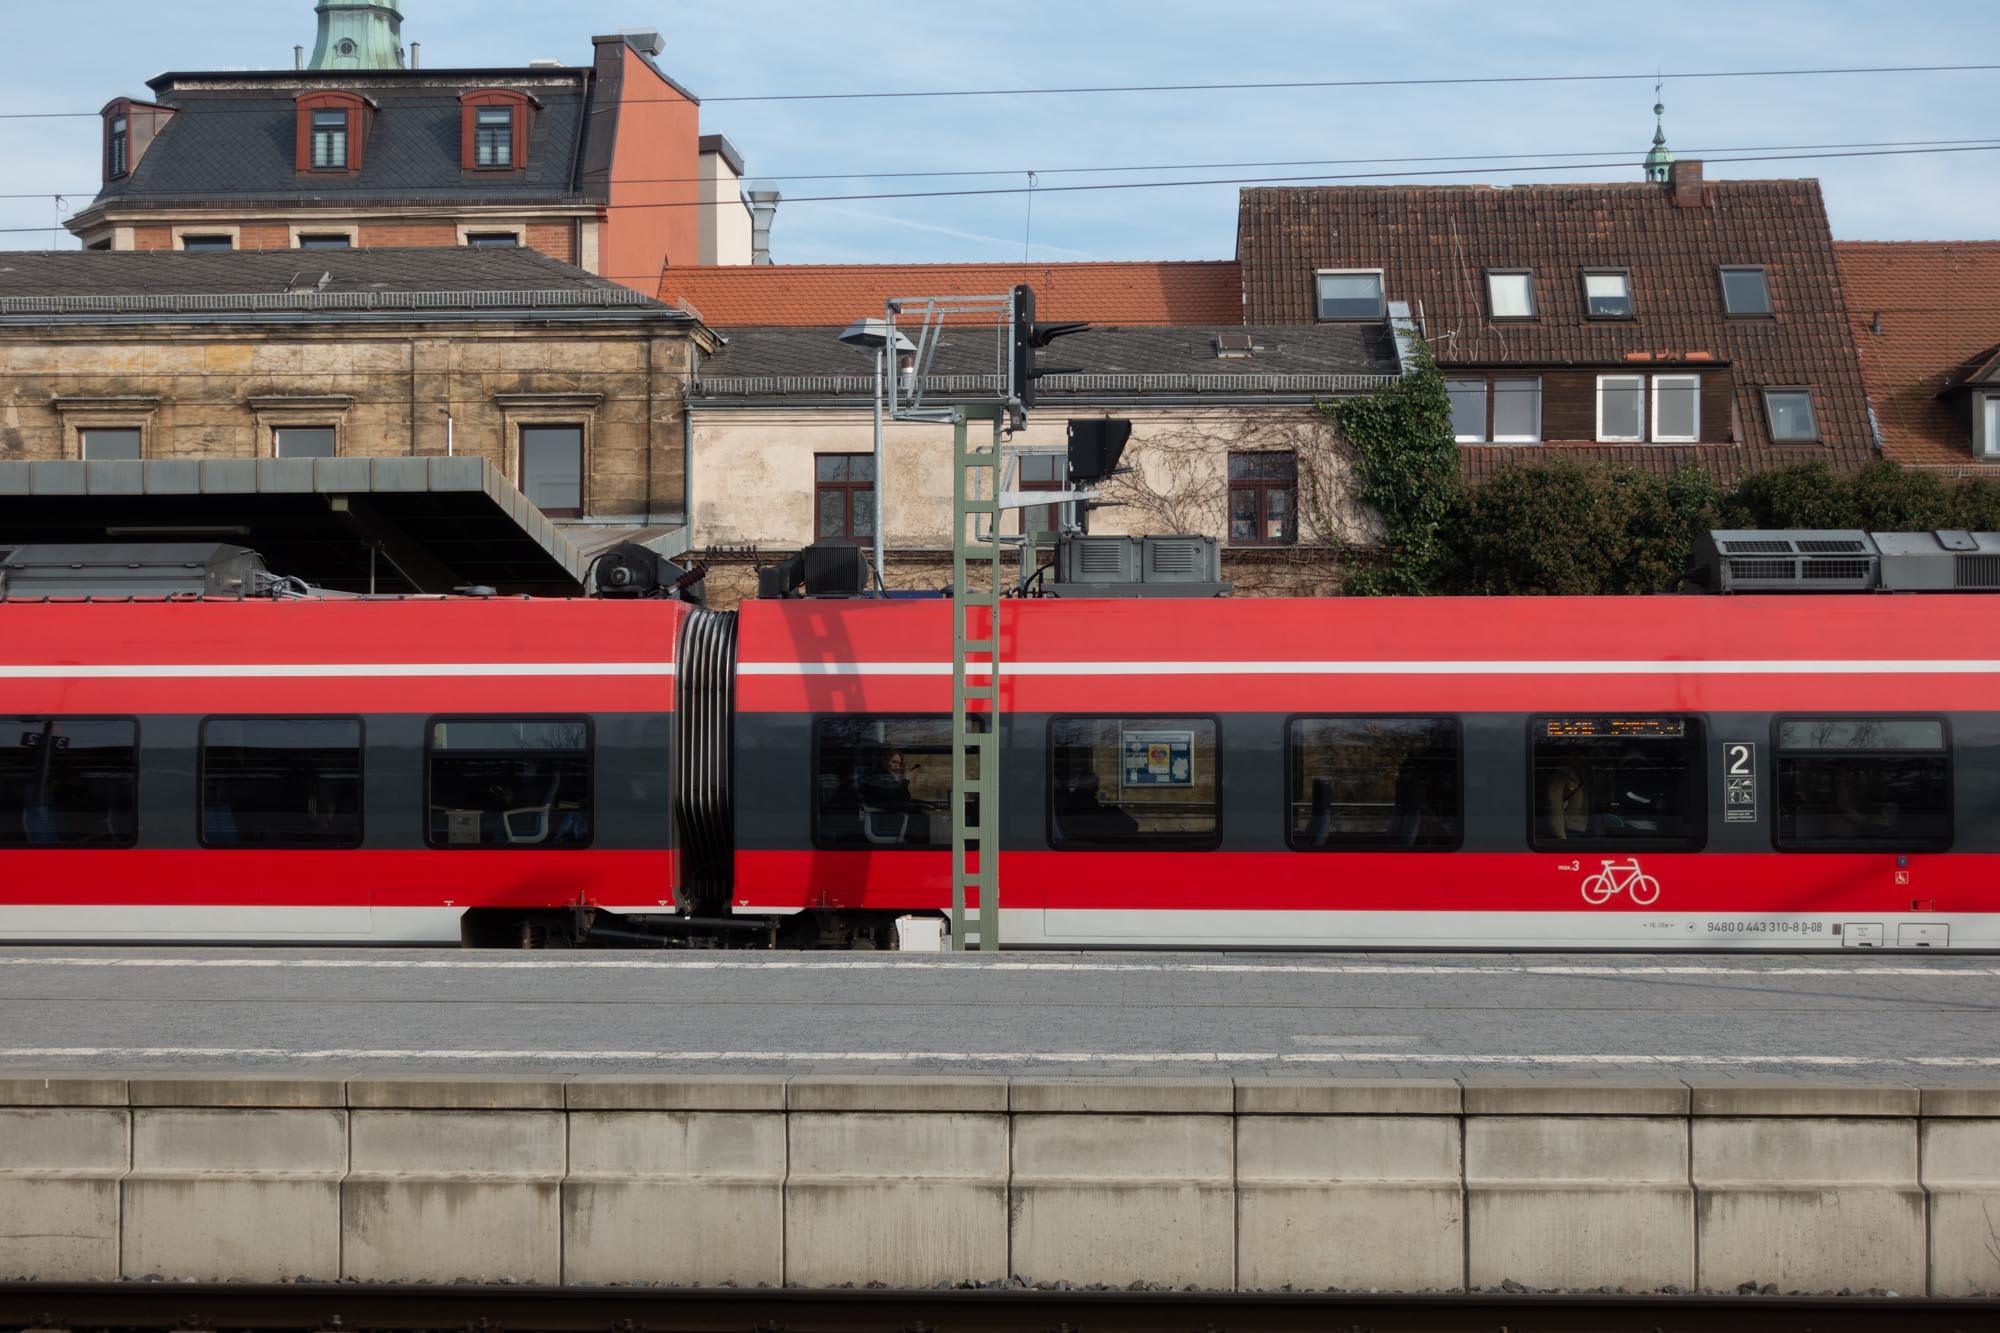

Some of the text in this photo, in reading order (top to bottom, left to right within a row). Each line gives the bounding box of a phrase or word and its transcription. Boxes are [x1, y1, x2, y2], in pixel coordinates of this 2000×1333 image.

[1729, 745, 1749, 774] 2
[1707, 922, 1735, 932] 9480
[1737, 922, 1744, 932] 0
[1746, 922, 1766, 932] 443
[1769, 922, 1799, 932] 310-8
